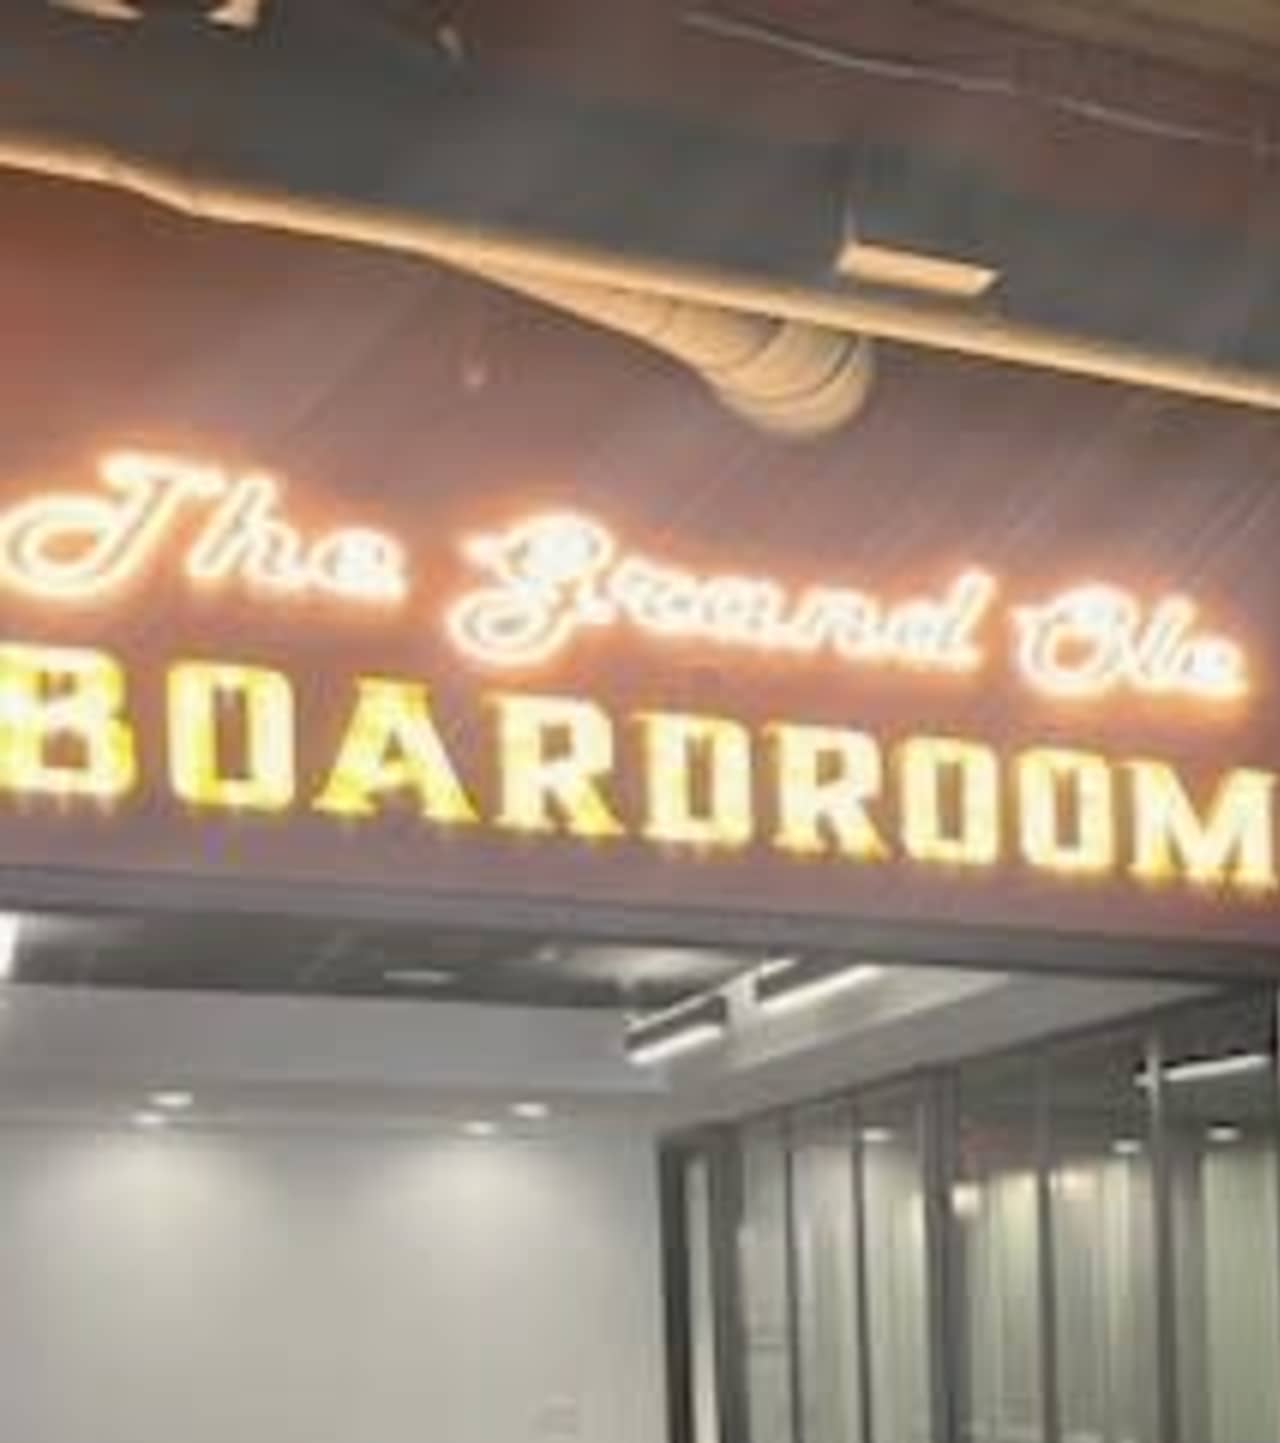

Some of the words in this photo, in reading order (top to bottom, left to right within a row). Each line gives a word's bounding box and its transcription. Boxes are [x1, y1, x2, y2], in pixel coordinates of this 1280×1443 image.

[0, 446, 410, 602] The
[445, 510, 1000, 672] Grand
[1010, 582, 1250, 699] Ole
